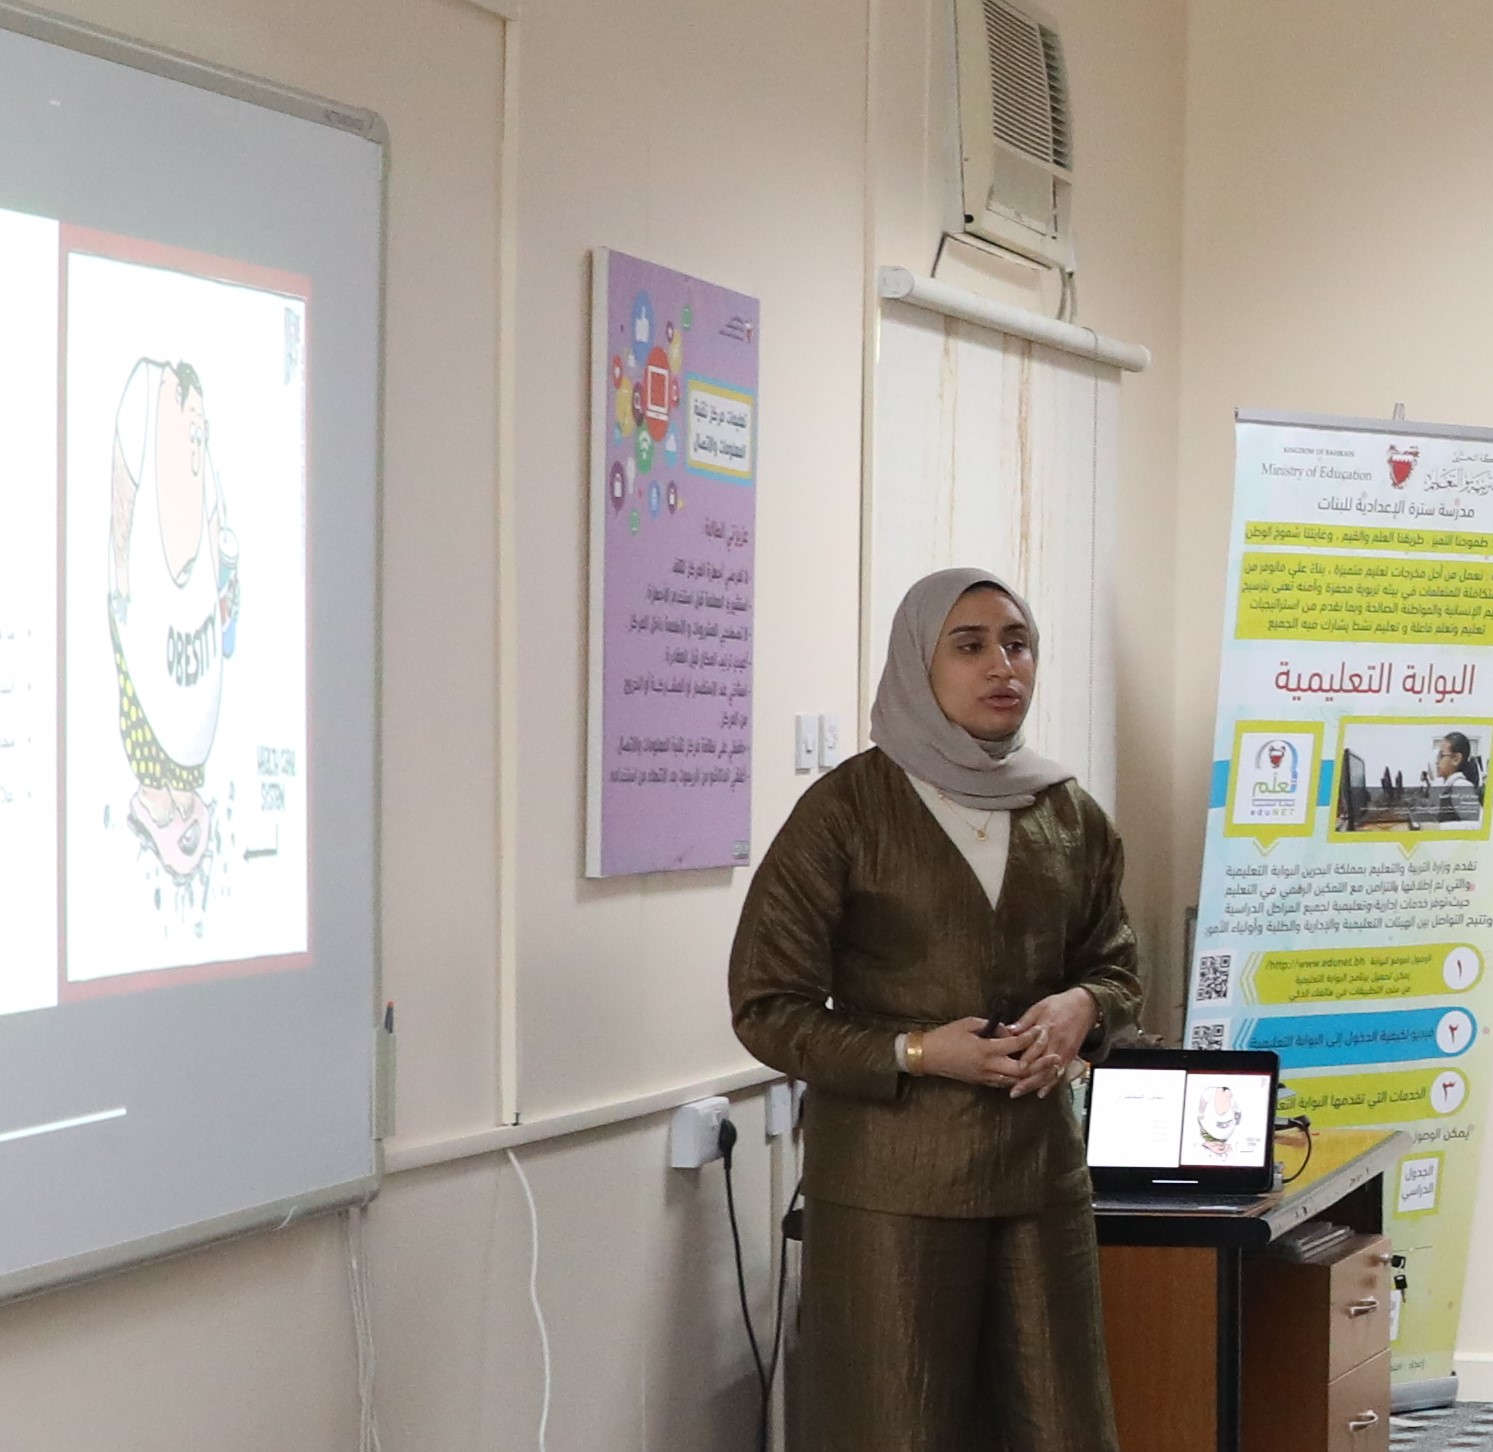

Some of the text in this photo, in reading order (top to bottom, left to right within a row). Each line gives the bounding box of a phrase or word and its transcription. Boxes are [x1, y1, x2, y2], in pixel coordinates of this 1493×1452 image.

[1262, 463, 1371, 481] Ministry of Education
[167, 603, 216, 687] OBESITY
[1275, 662, 1475, 703] البوابة التعليمية
